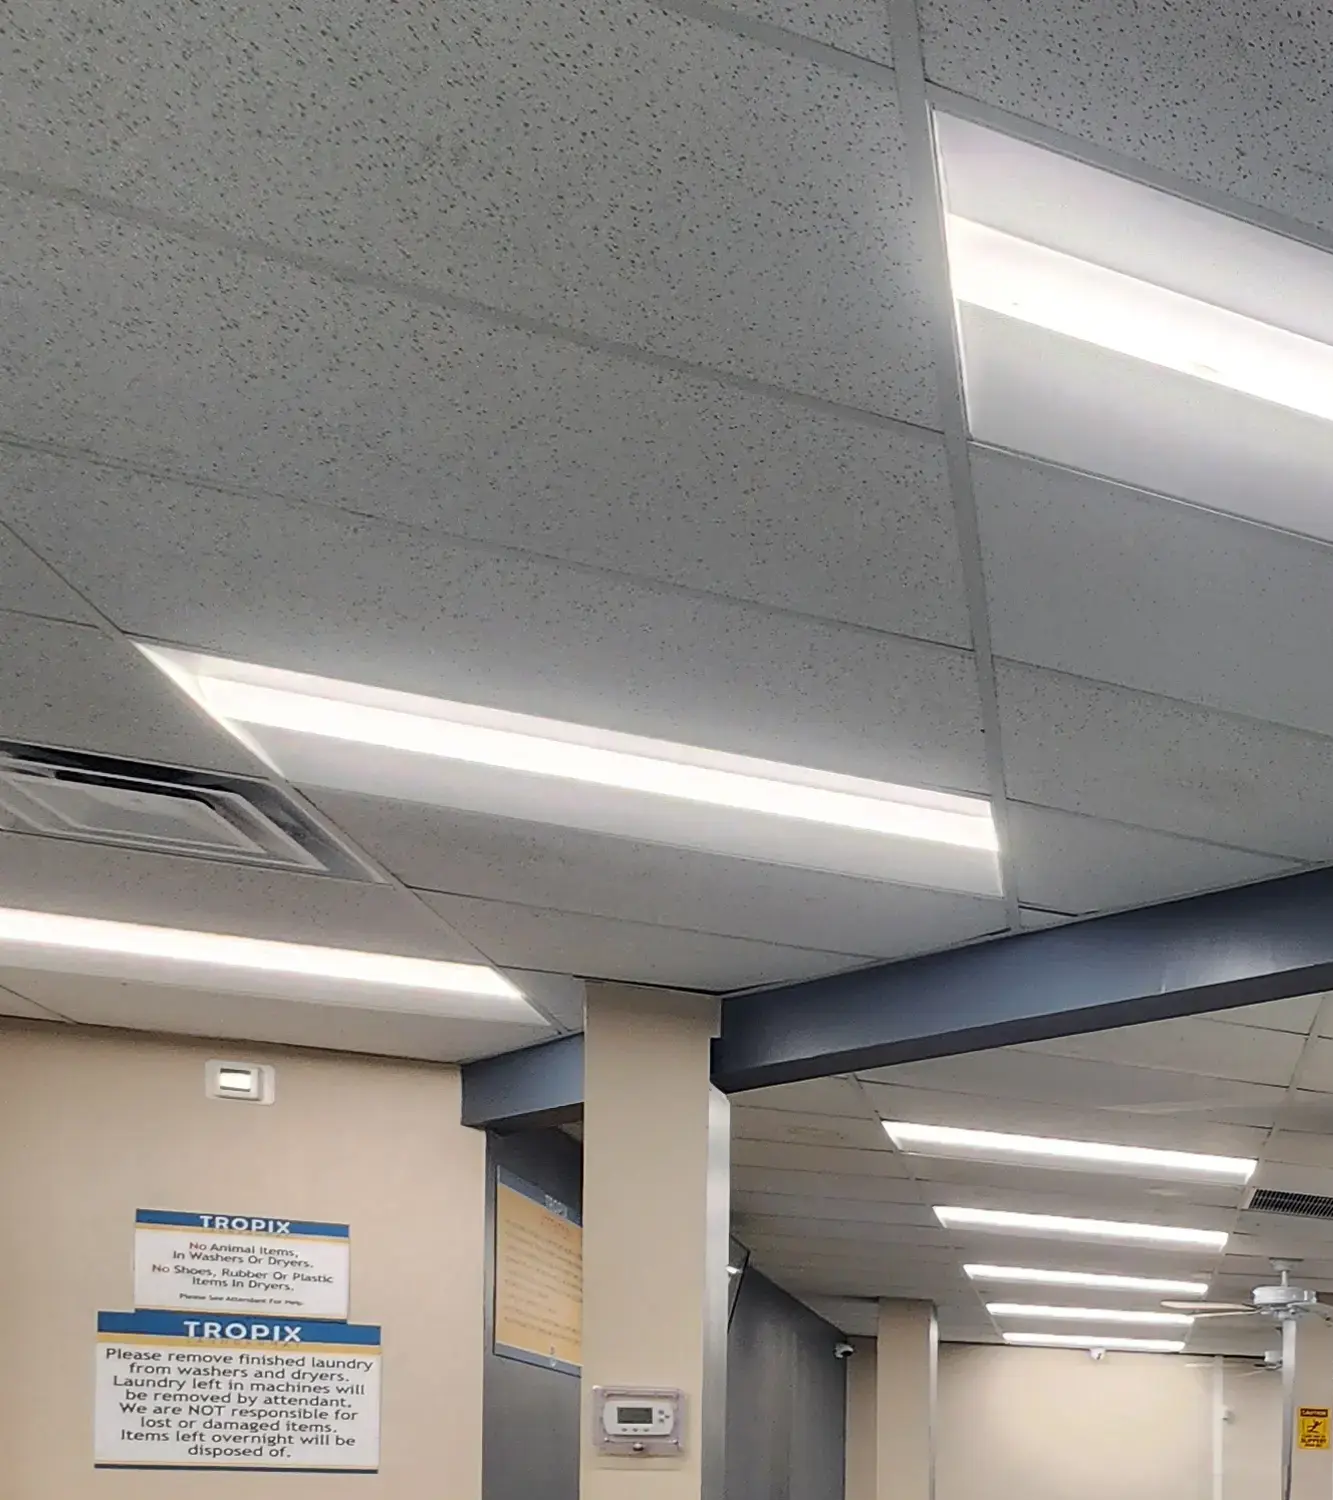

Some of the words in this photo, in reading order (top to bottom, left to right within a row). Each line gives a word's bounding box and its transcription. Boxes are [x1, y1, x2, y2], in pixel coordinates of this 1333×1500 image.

[200, 1216, 290, 1234] TROPIX
[189, 1242, 206, 1250] No
[211, 1244, 255, 1253] Animal
[260, 1247, 298, 1258] Items,
[190, 1252, 244, 1263] Washers
[248, 1256, 263, 1264] Or
[268, 1257, 313, 1269] Dryers.
[152, 1265, 169, 1273] No
[174, 1265, 217, 1277] Shoes,
[222, 1268, 268, 1280] Rubber
[273, 1272, 289, 1281] Or
[293, 1273, 334, 1284] Plastic
[192, 1277, 228, 1287] Items
[232, 1280, 244, 1288] In
[249, 1280, 294, 1292] Dryers.
[184, 1321, 302, 1343] TROPIX
[106, 1348, 161, 1361] Please
[168, 1352, 232, 1364] remove
[239, 1353, 305, 1367] finished
[312, 1356, 373, 1372] laundry
[129, 1363, 171, 1374] from
[178, 1366, 247, 1378] washers
[254, 1369, 285, 1380] and
[291, 1370, 350, 1383] dryers.
[114, 1376, 186, 1390] Laundry
[193, 1378, 221, 1391] left
[229, 1380, 244, 1391] in
[250, 1381, 330, 1394] machines
[336, 1384, 364, 1395] will
[126, 1390, 147, 1400] be
[154, 1391, 231, 1404] removed
[238, 1393, 258, 1407] by
[264, 1394, 352, 1407] attendant.
[119, 1403, 147, 1414] We
[153, 1406, 182, 1415] are
[188, 1405, 226, 1417] NOT
[231, 1407, 329, 1422] responsible
[335, 1409, 358, 1421] for
[141, 1417, 172, 1429] lost
[178, 1419, 196, 1429] or
[203, 1419, 279, 1433] damaged
[286, 1421, 337, 1433] items.
[121, 1429, 169, 1441] Items
[177, 1431, 204, 1443] left
[211, 1433, 294, 1447] overnight
[300, 1435, 329, 1445] will
[335, 1435, 355, 1446] be
[188, 1445, 263, 1459] disposed
[269, 1446, 291, 1458] of.
